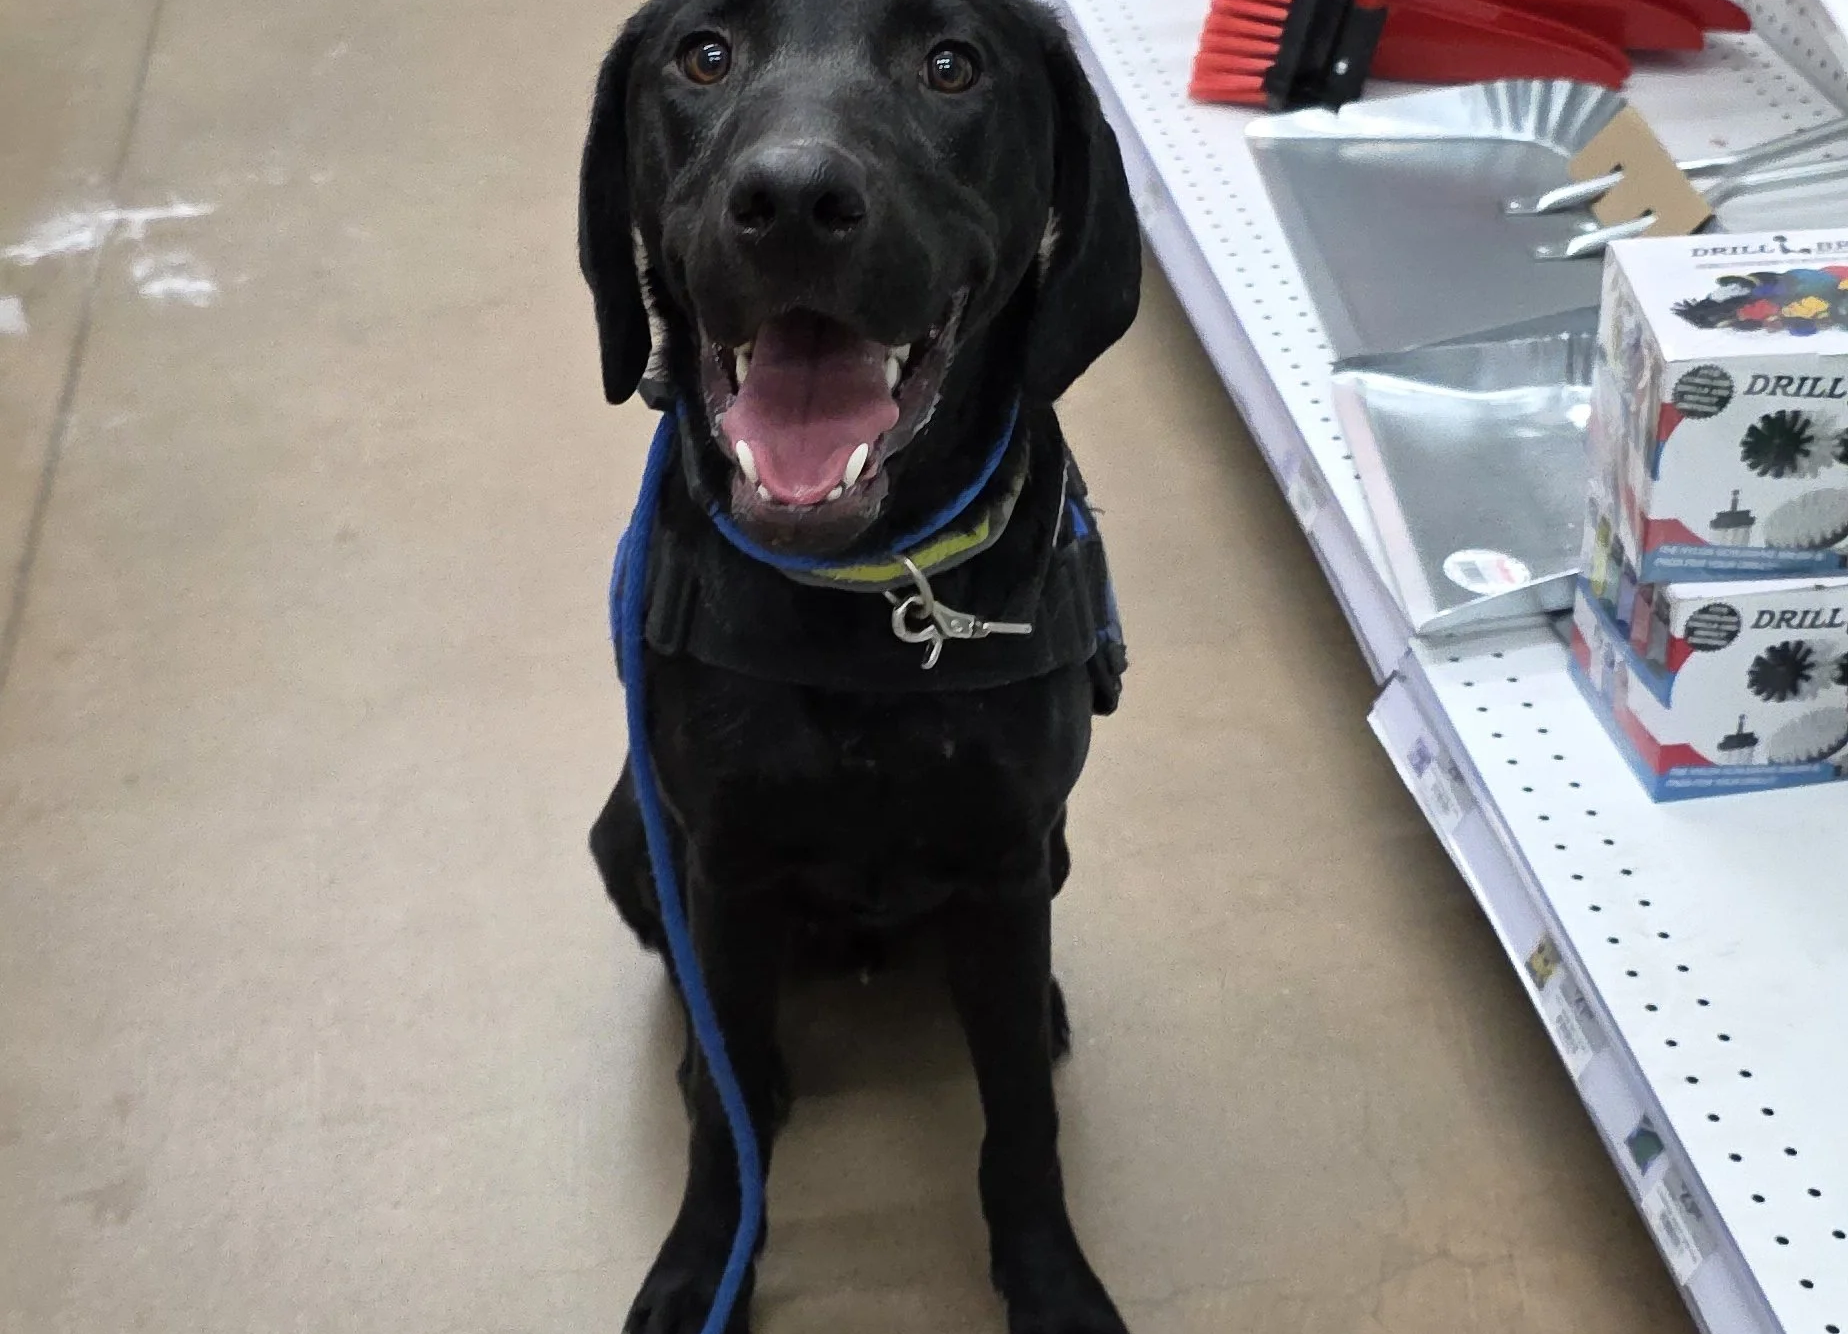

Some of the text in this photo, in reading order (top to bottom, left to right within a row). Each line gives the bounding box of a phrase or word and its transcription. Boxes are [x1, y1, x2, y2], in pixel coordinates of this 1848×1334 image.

[1691, 244, 1776, 257] DRILL
[1743, 374, 1848, 399] DRILL
[1750, 607, 1847, 630] DRILL
